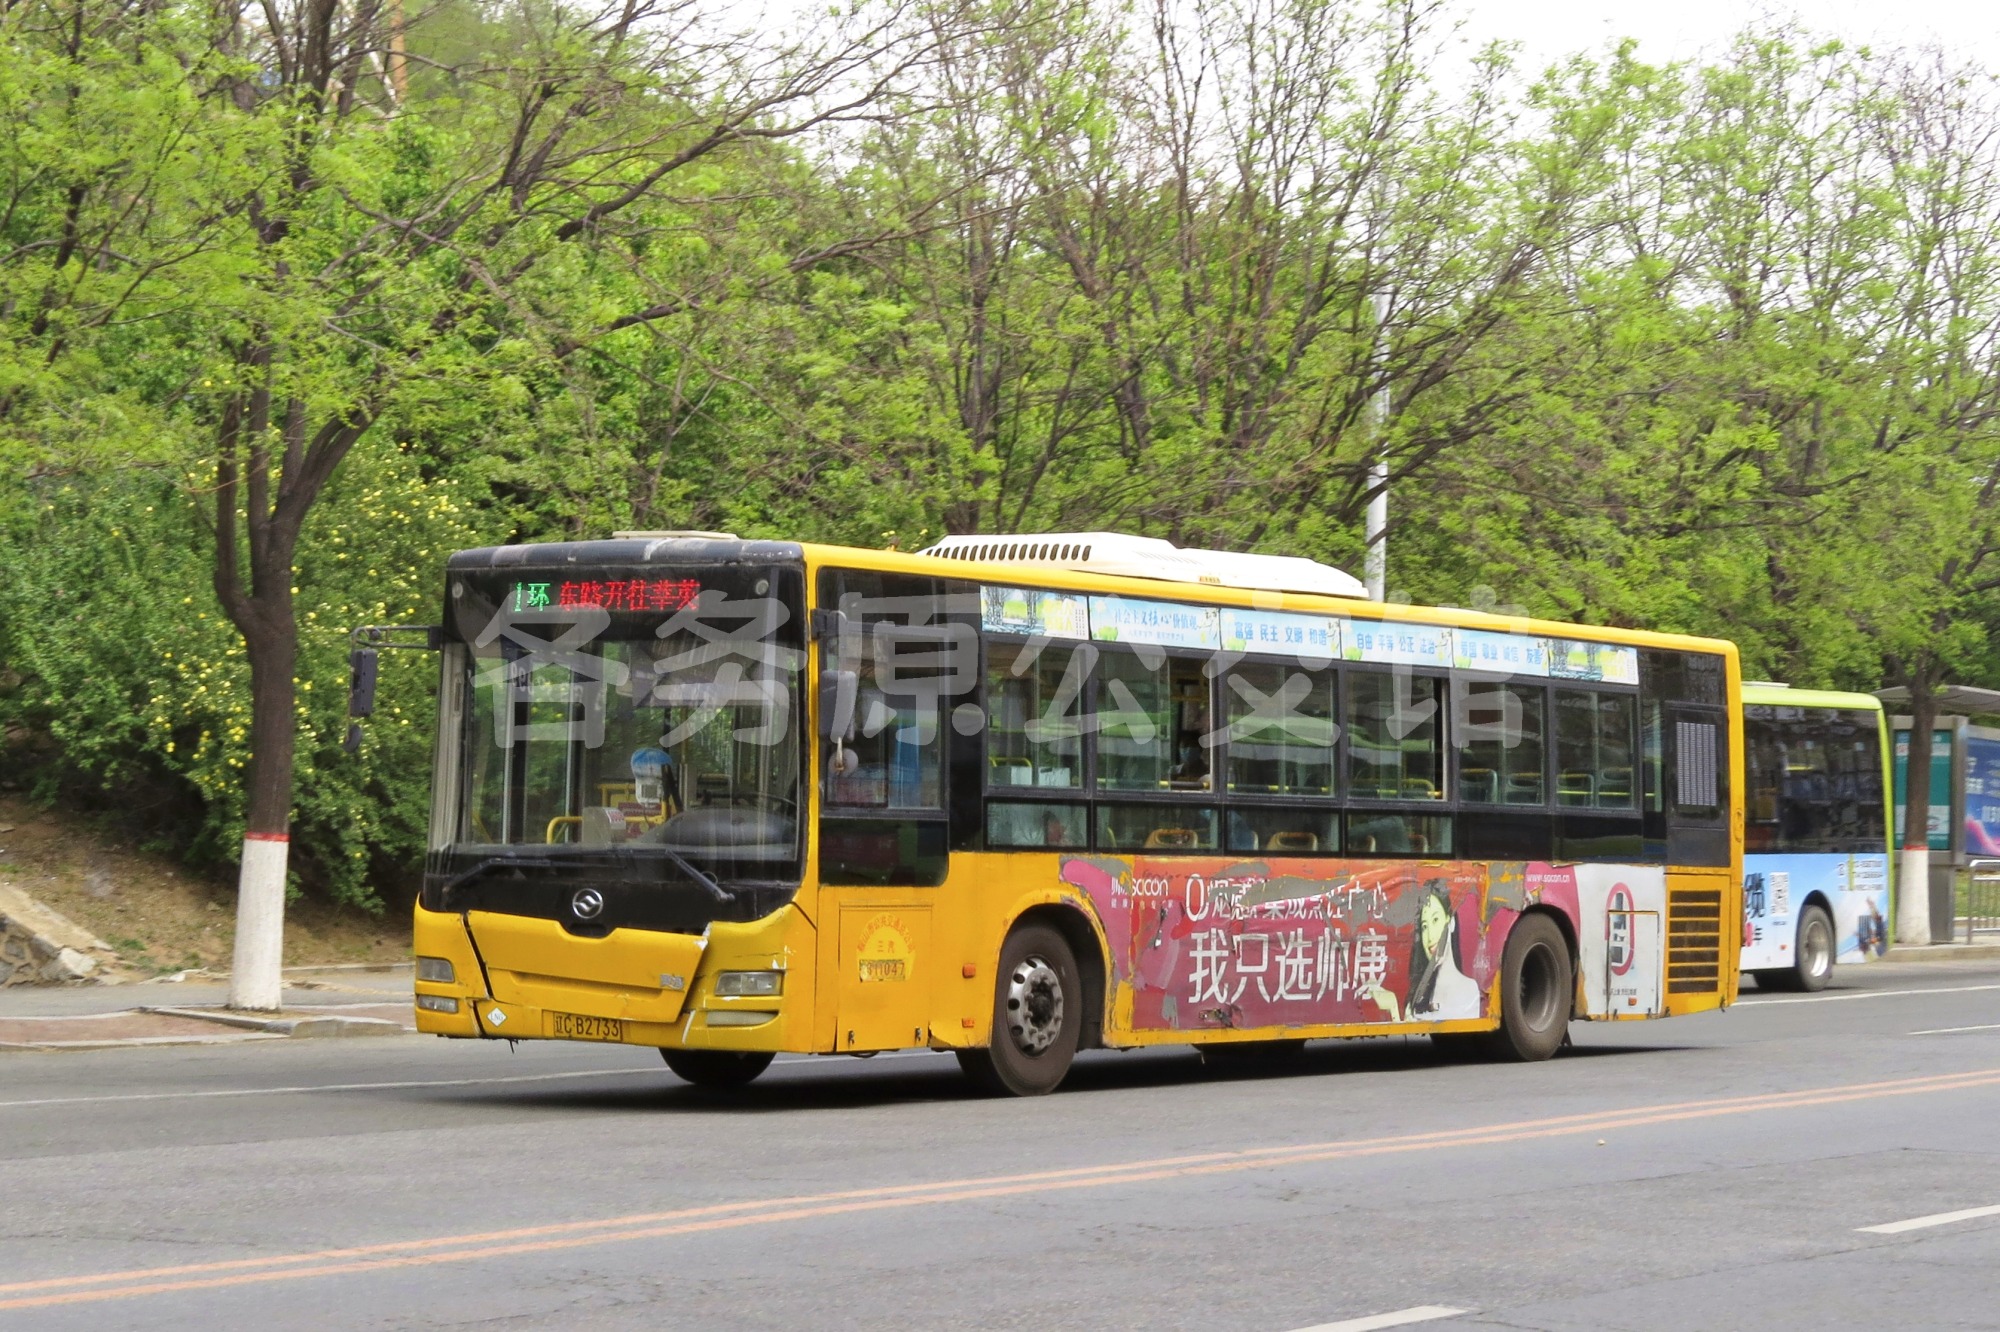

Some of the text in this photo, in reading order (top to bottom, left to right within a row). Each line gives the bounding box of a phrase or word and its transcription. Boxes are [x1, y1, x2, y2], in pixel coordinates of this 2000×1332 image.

[1235, 621, 1327, 646] 富强 民主 文明 和谐
[1356, 633, 1373, 651] 自由
[1378, 634, 1394, 652] 平等
[1399, 636, 1415, 653] 公正
[1188, 927, 1388, 1004] 我只选帅康
[490, 1012, 504, 1021] LNG
